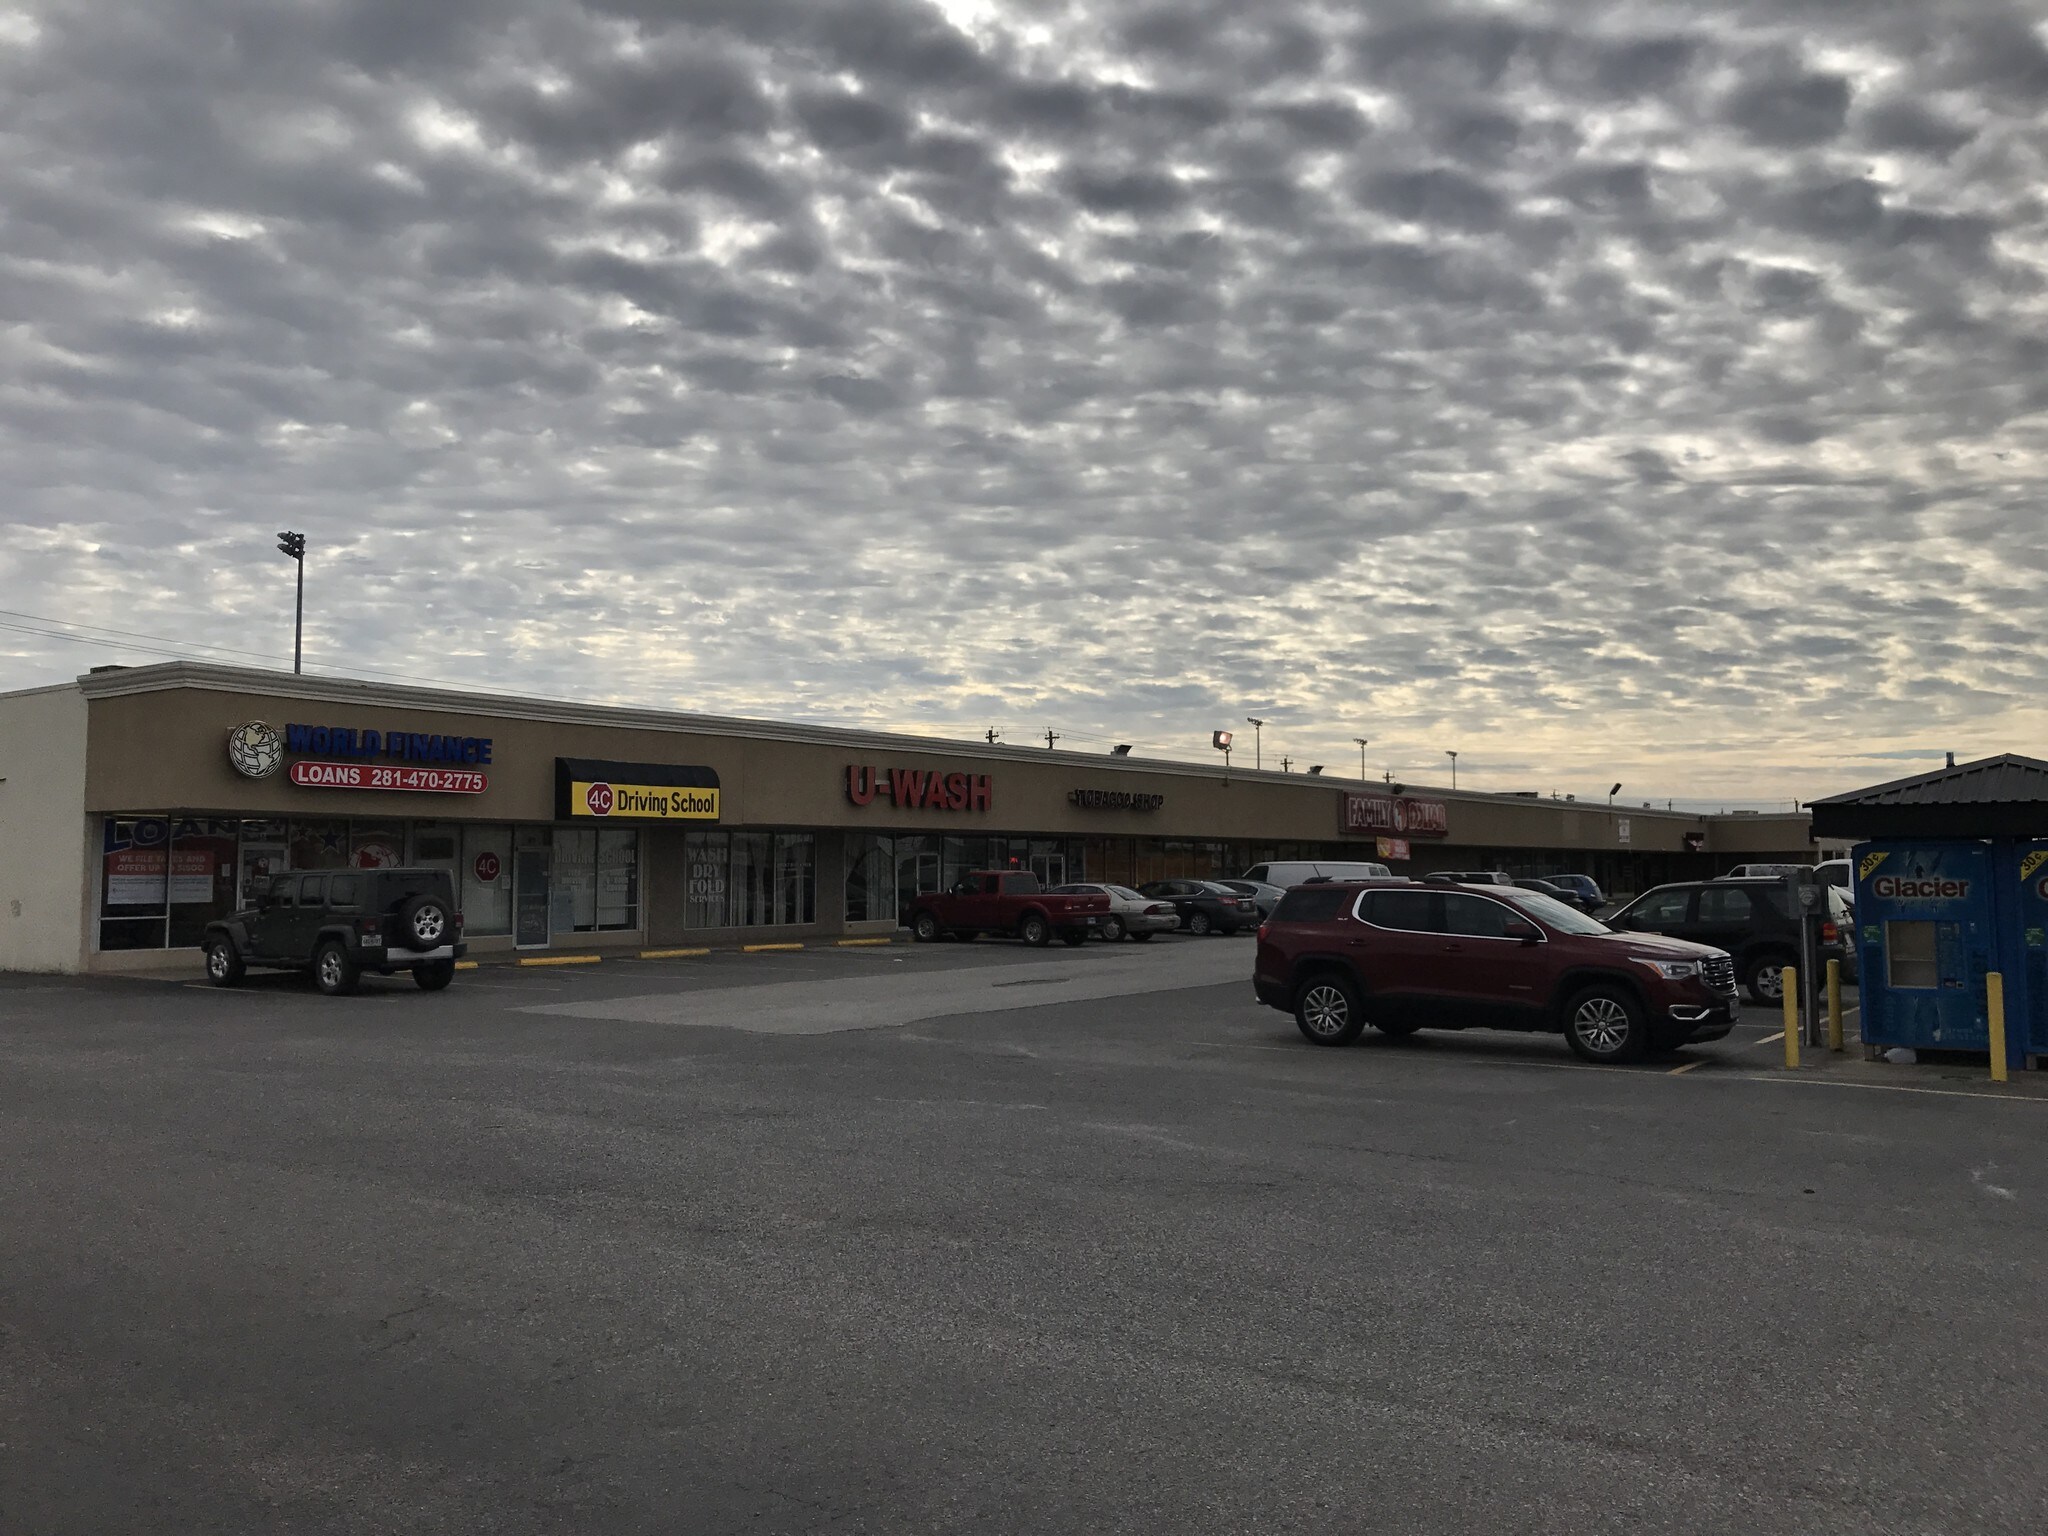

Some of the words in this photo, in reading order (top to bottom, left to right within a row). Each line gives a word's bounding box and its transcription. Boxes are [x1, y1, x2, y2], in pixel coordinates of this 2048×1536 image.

[286, 723, 381, 758] WORLD
[387, 731, 493, 765] FINANCE
[297, 765, 361, 784] LOANS
[371, 768, 483, 790] 281-470-2775
[847, 765, 992, 812] U-WASH
[588, 790, 611, 809] 4C
[618, 789, 668, 816] Driving
[671, 791, 715, 813] School
[1078, 789, 1131, 808] TOBACCO
[1135, 793, 1164, 809] SHOP
[1348, 797, 1392, 828] FAMILY
[598, 848, 637, 865] SCHOOL
[687, 847, 728, 863] WASH
[117, 864, 147, 872] OFFER
[148, 864, 161, 872] UP
[478, 858, 497, 874] 4C
[693, 863, 721, 878] DRY
[689, 879, 725, 894] FOLD
[1874, 877, 1969, 898] Glacier
